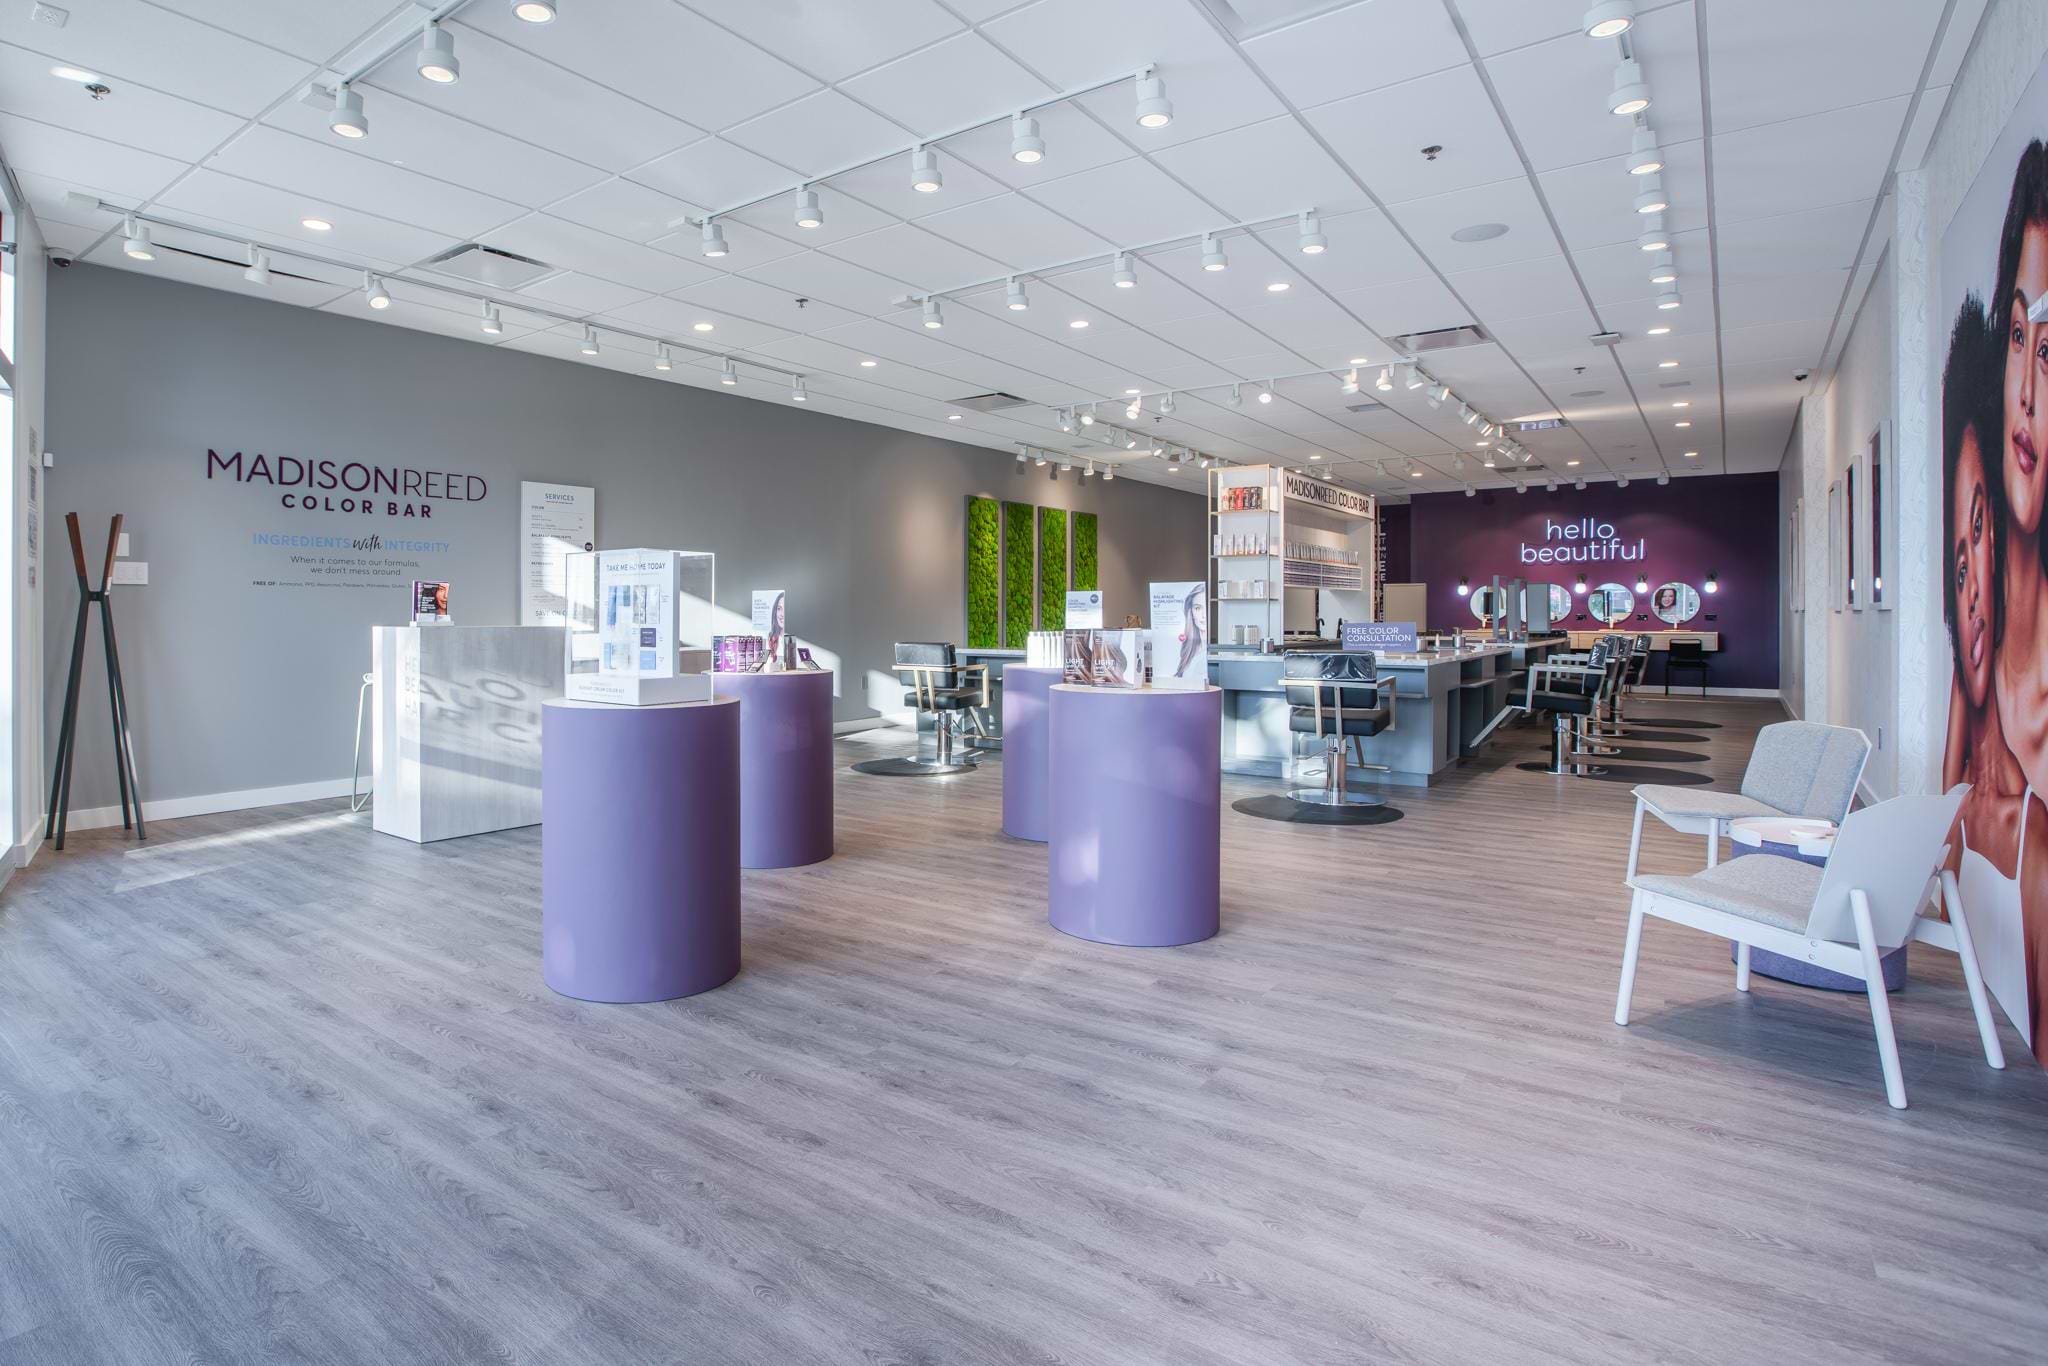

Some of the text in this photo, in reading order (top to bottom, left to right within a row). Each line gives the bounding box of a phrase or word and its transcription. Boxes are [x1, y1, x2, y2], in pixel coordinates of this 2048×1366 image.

[207, 448, 487, 501] MADISONREED
[544, 493, 575, 501] SERVICES
[1286, 476, 1370, 513] MADISONREED COLOR BAR
[282, 493, 431, 518] COLOR BAR
[1547, 517, 1615, 541] hello
[252, 533, 450, 553] INGREDIENTS with INTEGRITY
[1521, 538, 1645, 563] beautiful
[290, 555, 317, 564] When
[384, 559, 420, 568] formulas,
[606, 563, 620, 571] TAKE
[620, 563, 628, 571] ME
[647, 562, 666, 570] TODAY
[325, 566, 346, 574] don't
[372, 568, 401, 576] around
[1346, 627, 1399, 635] FREE COLOR
[1346, 634, 1412, 642] CONSULTATION
[1094, 658, 1115, 666] LIGHT
